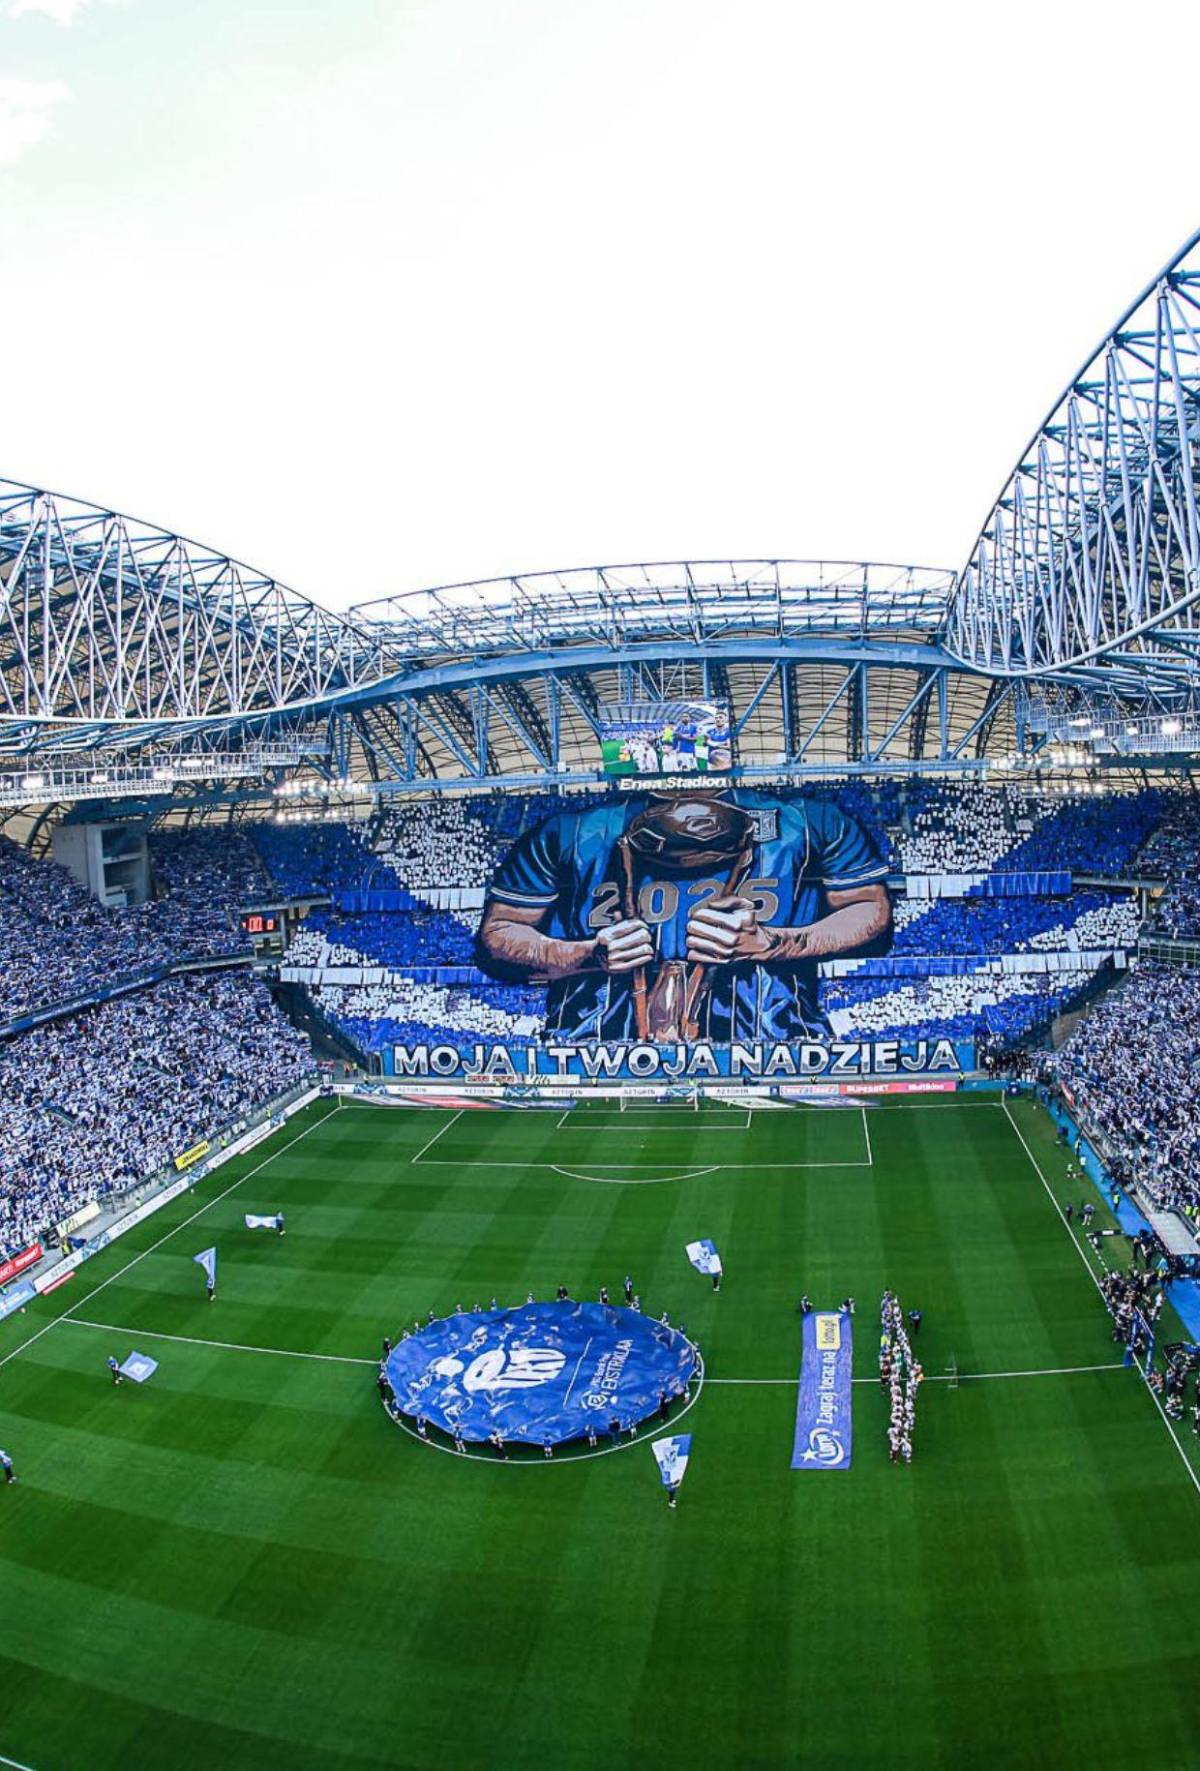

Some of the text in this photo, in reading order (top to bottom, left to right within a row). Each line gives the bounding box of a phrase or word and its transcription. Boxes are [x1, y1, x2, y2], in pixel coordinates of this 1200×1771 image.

[619, 776, 727, 790] Enea Stadion
[589, 878, 778, 927] 2025
[393, 1039, 959, 1077] MOJA I TWOJA NADZIEJA
[823, 1350, 836, 1362] na
[820, 1362, 836, 1390] teraz
[816, 1391, 838, 1424] Zagraj
